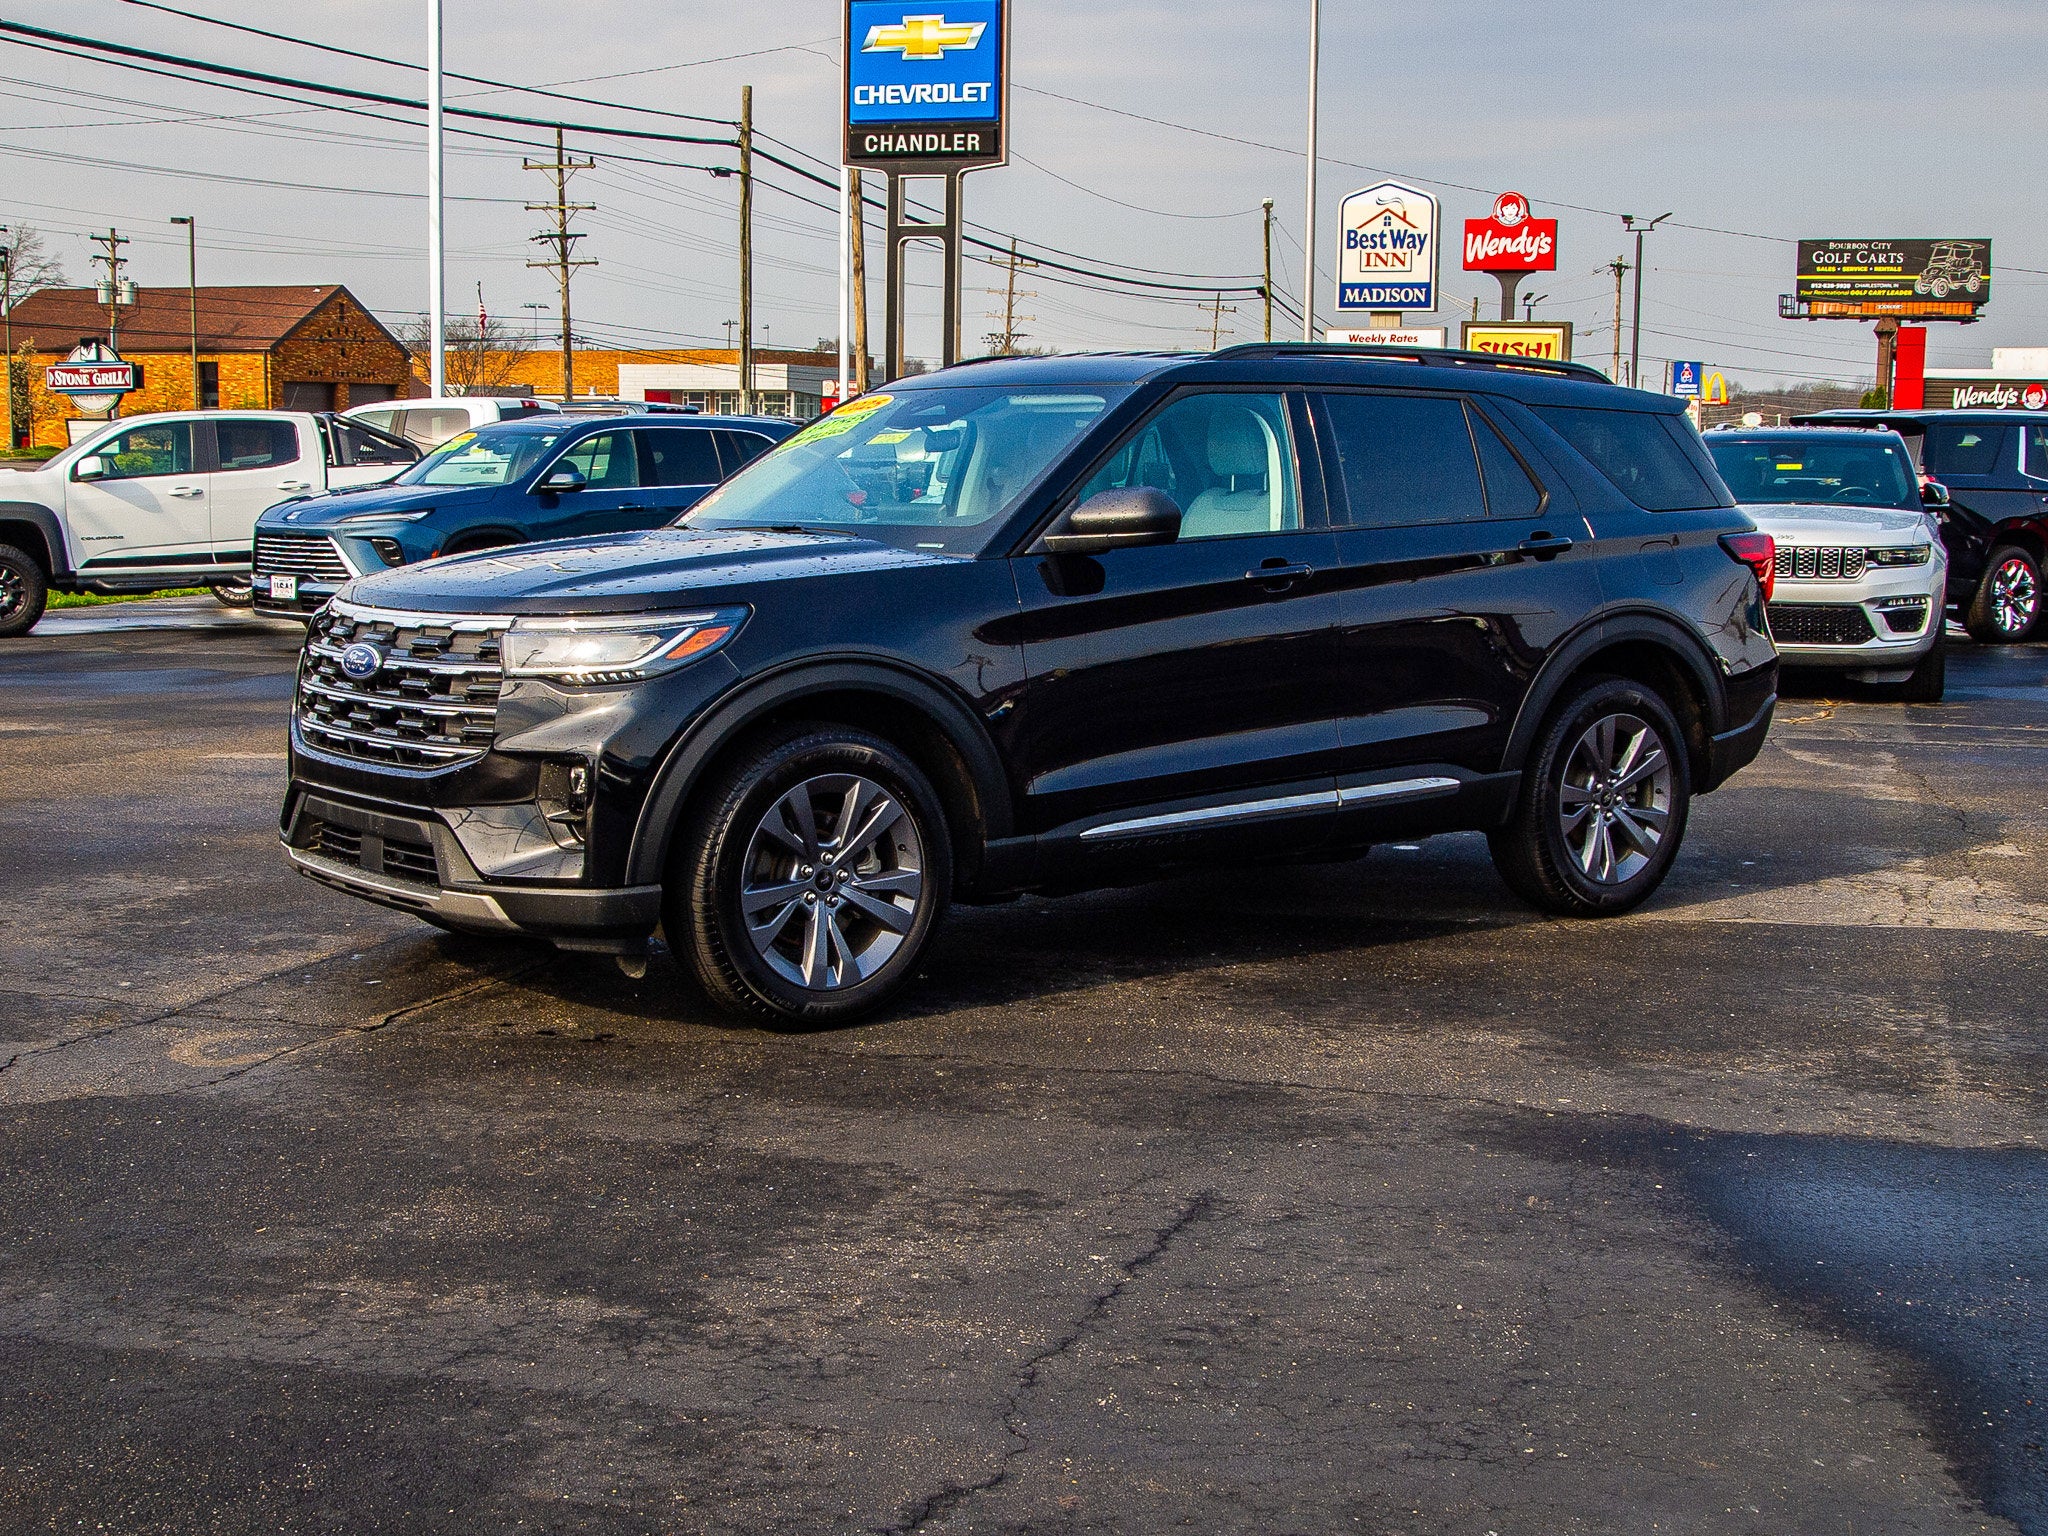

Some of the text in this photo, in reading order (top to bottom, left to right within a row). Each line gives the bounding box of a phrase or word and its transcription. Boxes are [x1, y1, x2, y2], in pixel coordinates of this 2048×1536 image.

[854, 82, 992, 105] CHEVROLET
[864, 133, 980, 152] CHANDLER
[1346, 229, 1428, 255] Best Way
[1466, 225, 1552, 263] Wendy's
[1829, 241, 1892, 250] BOURBON CITY
[1365, 252, 1408, 267] INN
[1812, 250, 1904, 264] GOLF CARTS
[1343, 288, 1426, 302] MADISON
[1349, 334, 1418, 344] Weekly Rates
[1478, 341, 1551, 358] SUSHI
[54, 370, 125, 386] STONE GRILL
[1953, 383, 2019, 410] Wendy's
